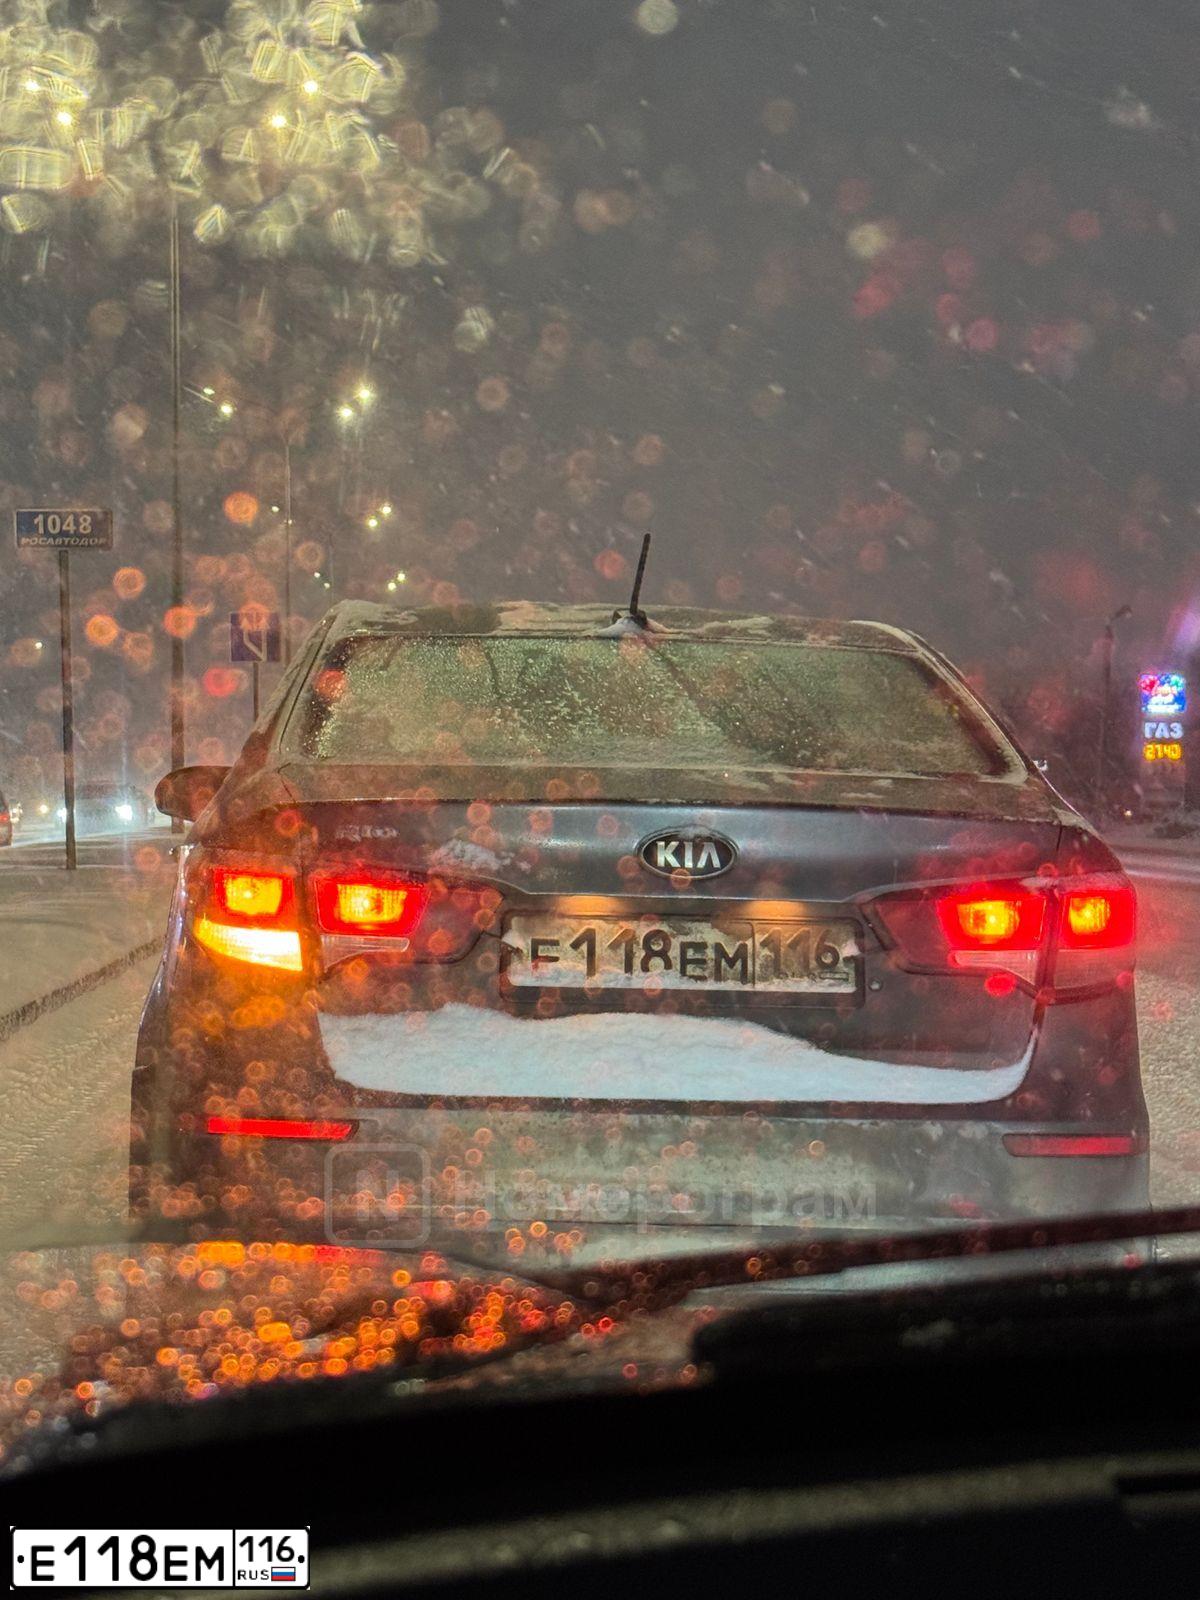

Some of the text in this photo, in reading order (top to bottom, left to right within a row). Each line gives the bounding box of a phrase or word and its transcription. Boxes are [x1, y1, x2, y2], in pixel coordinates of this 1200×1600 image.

[33, 514, 92, 534] 1048
[1144, 722, 1184, 739] ГАЗ
[656, 841, 721, 868] KIA
[759, 928, 840, 979] 116
